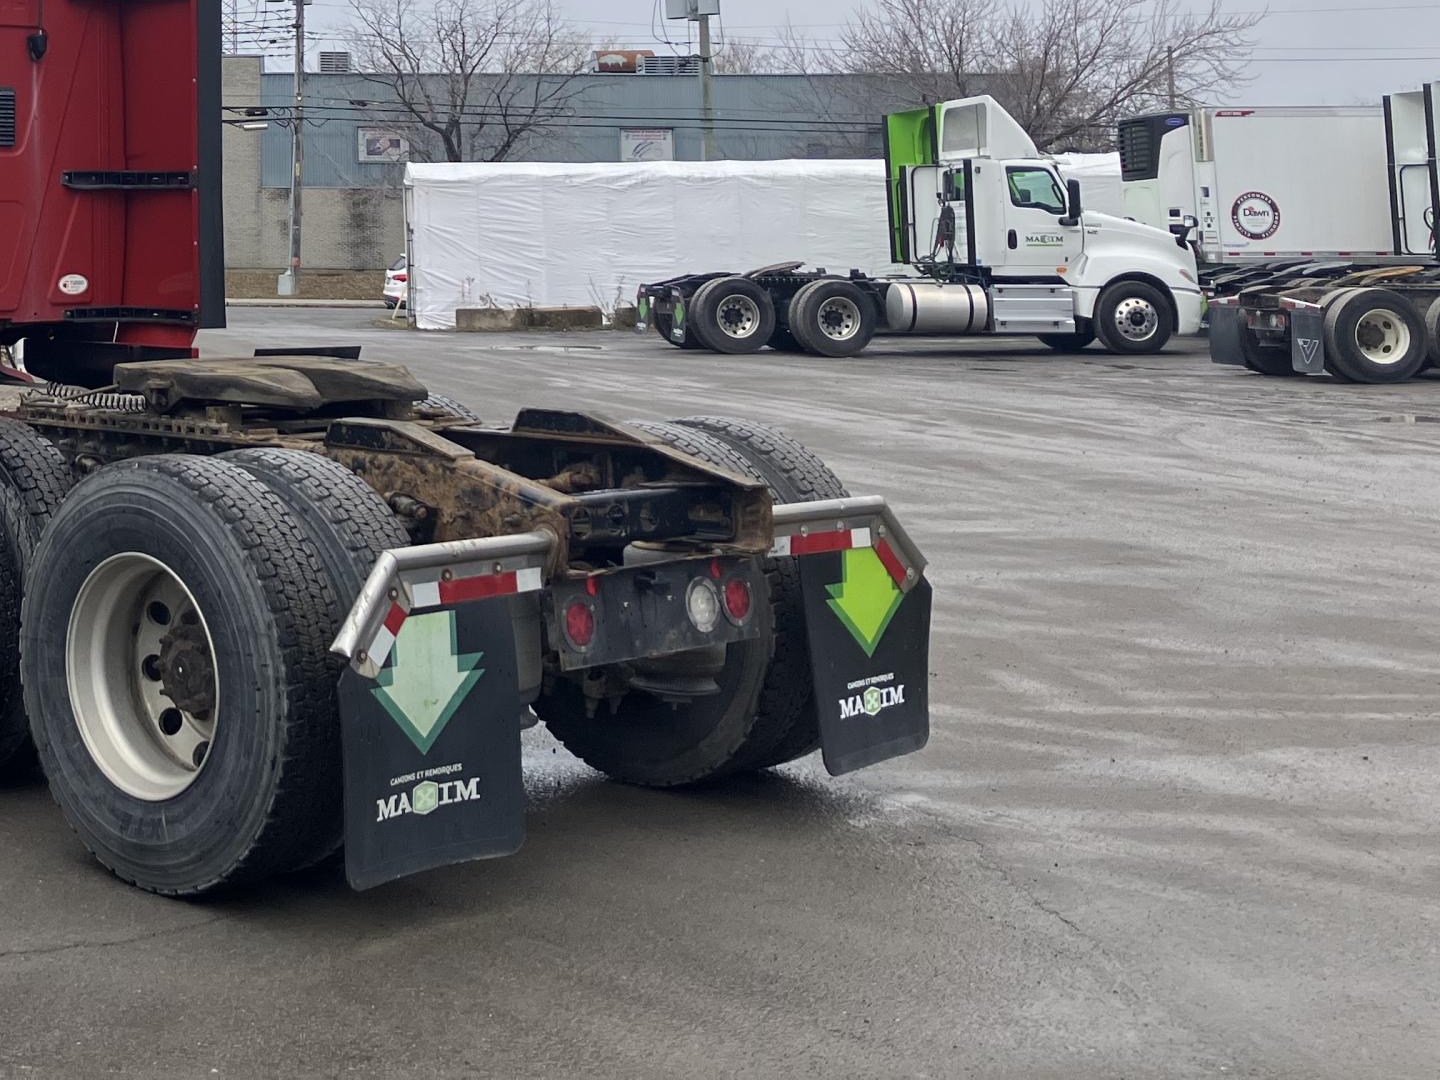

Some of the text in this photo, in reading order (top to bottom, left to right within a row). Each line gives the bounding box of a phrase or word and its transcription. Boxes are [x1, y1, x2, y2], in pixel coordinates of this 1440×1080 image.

[1243, 208, 1269, 217] Dawn
[838, 684, 905, 719] MAXIM
[390, 763, 463, 787] CAMIONS ET REMORQUES
[376, 777, 481, 822] MAXIM
